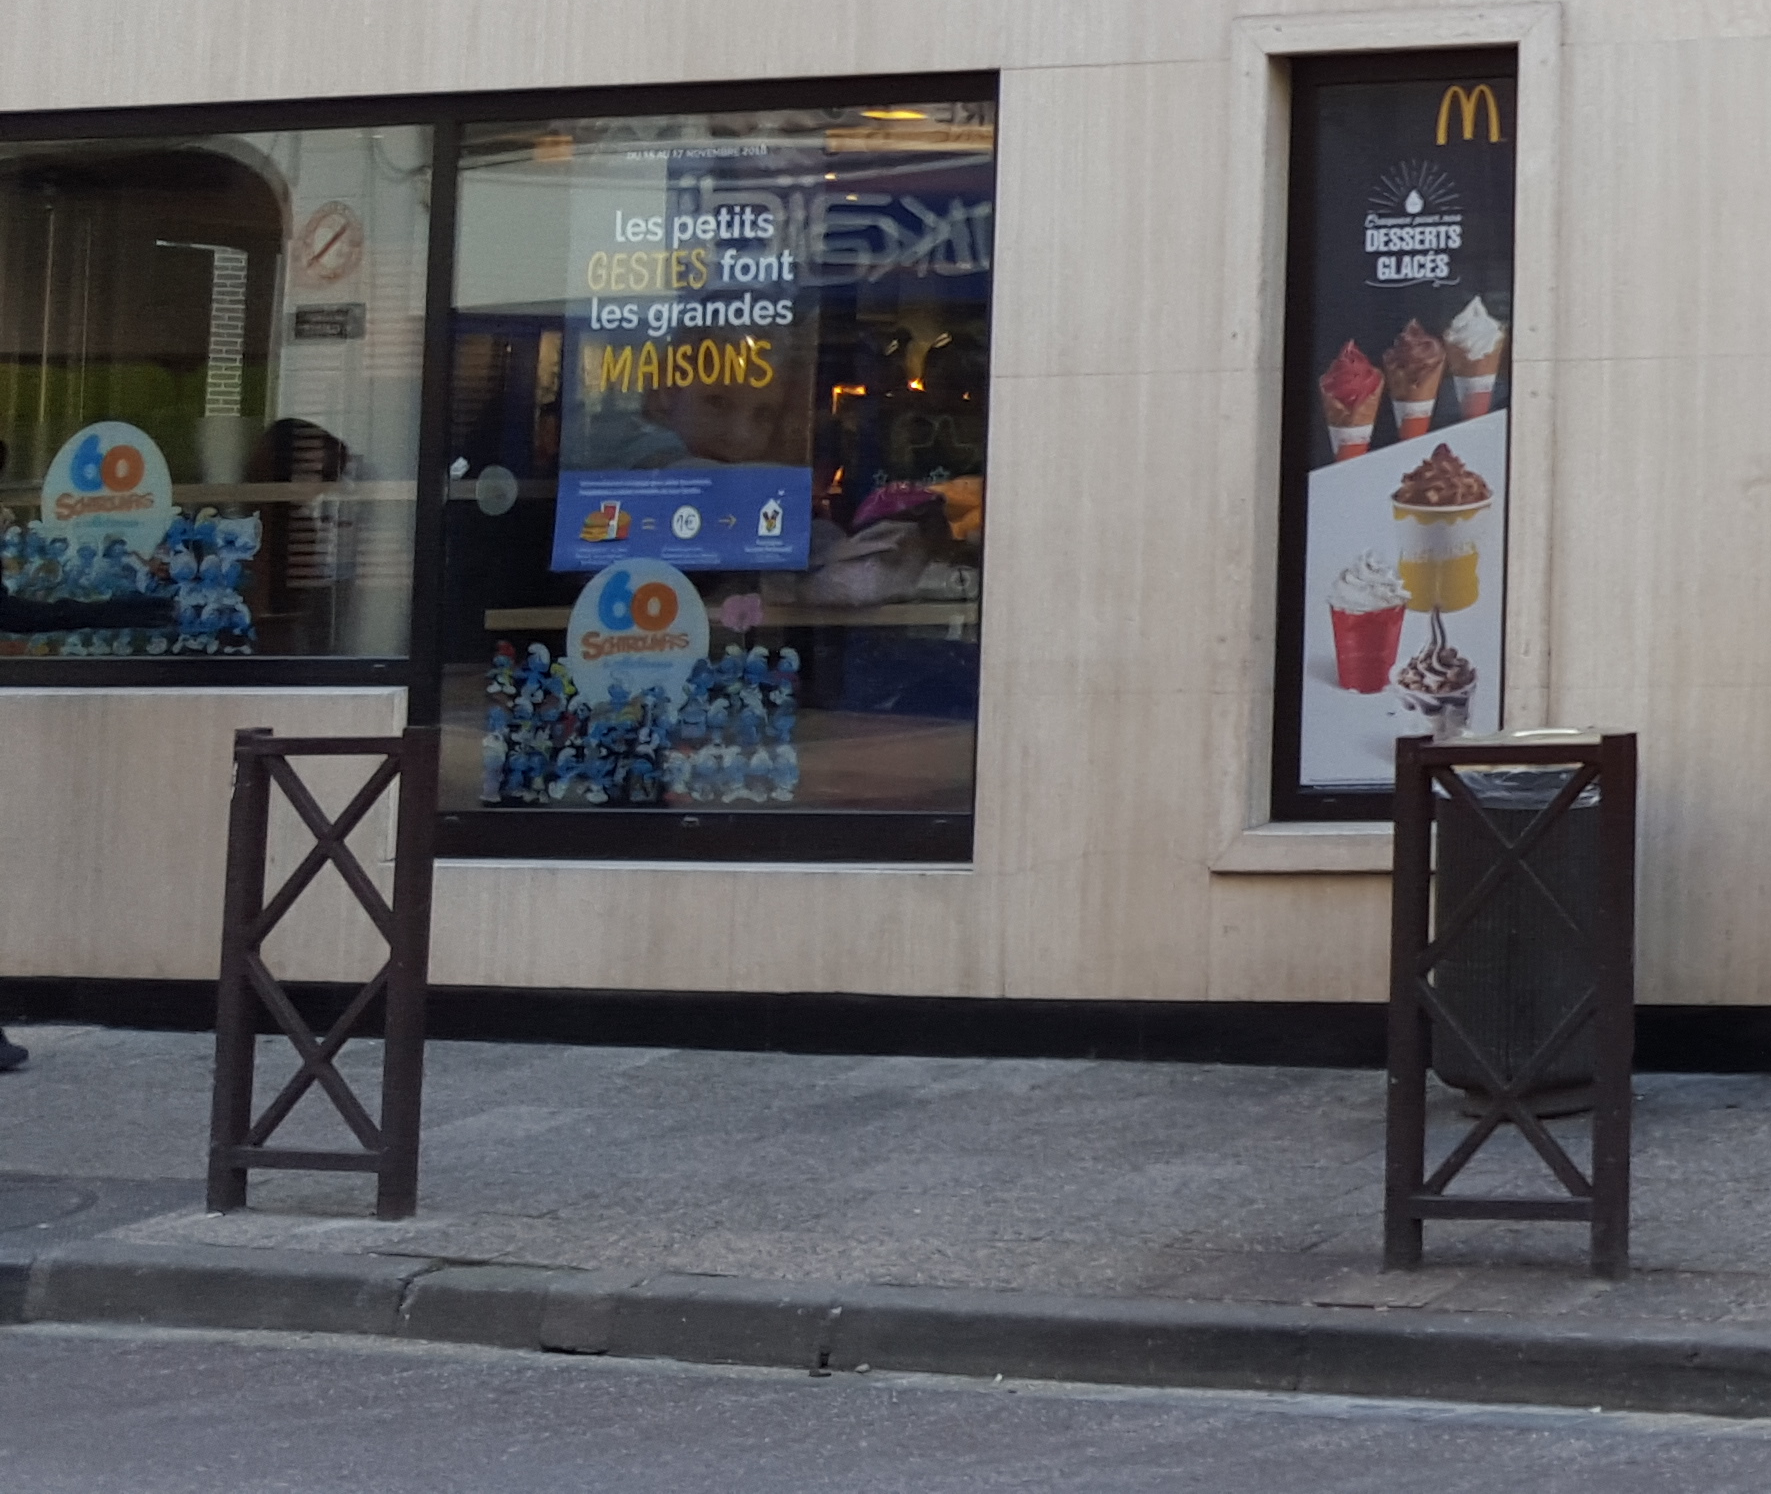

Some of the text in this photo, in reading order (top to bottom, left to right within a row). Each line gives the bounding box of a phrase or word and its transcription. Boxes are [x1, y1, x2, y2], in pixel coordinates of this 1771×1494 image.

[615, 206, 775, 248] les petits
[1364, 224, 1462, 253] DESSERTS
[587, 248, 795, 292] GESTES font
[1376, 251, 1451, 281] GLACÉS
[590, 292, 794, 337] les grandes
[70, 433, 145, 492] 60
[676, 512, 696, 533] 1€
[598, 569, 679, 632] 60
